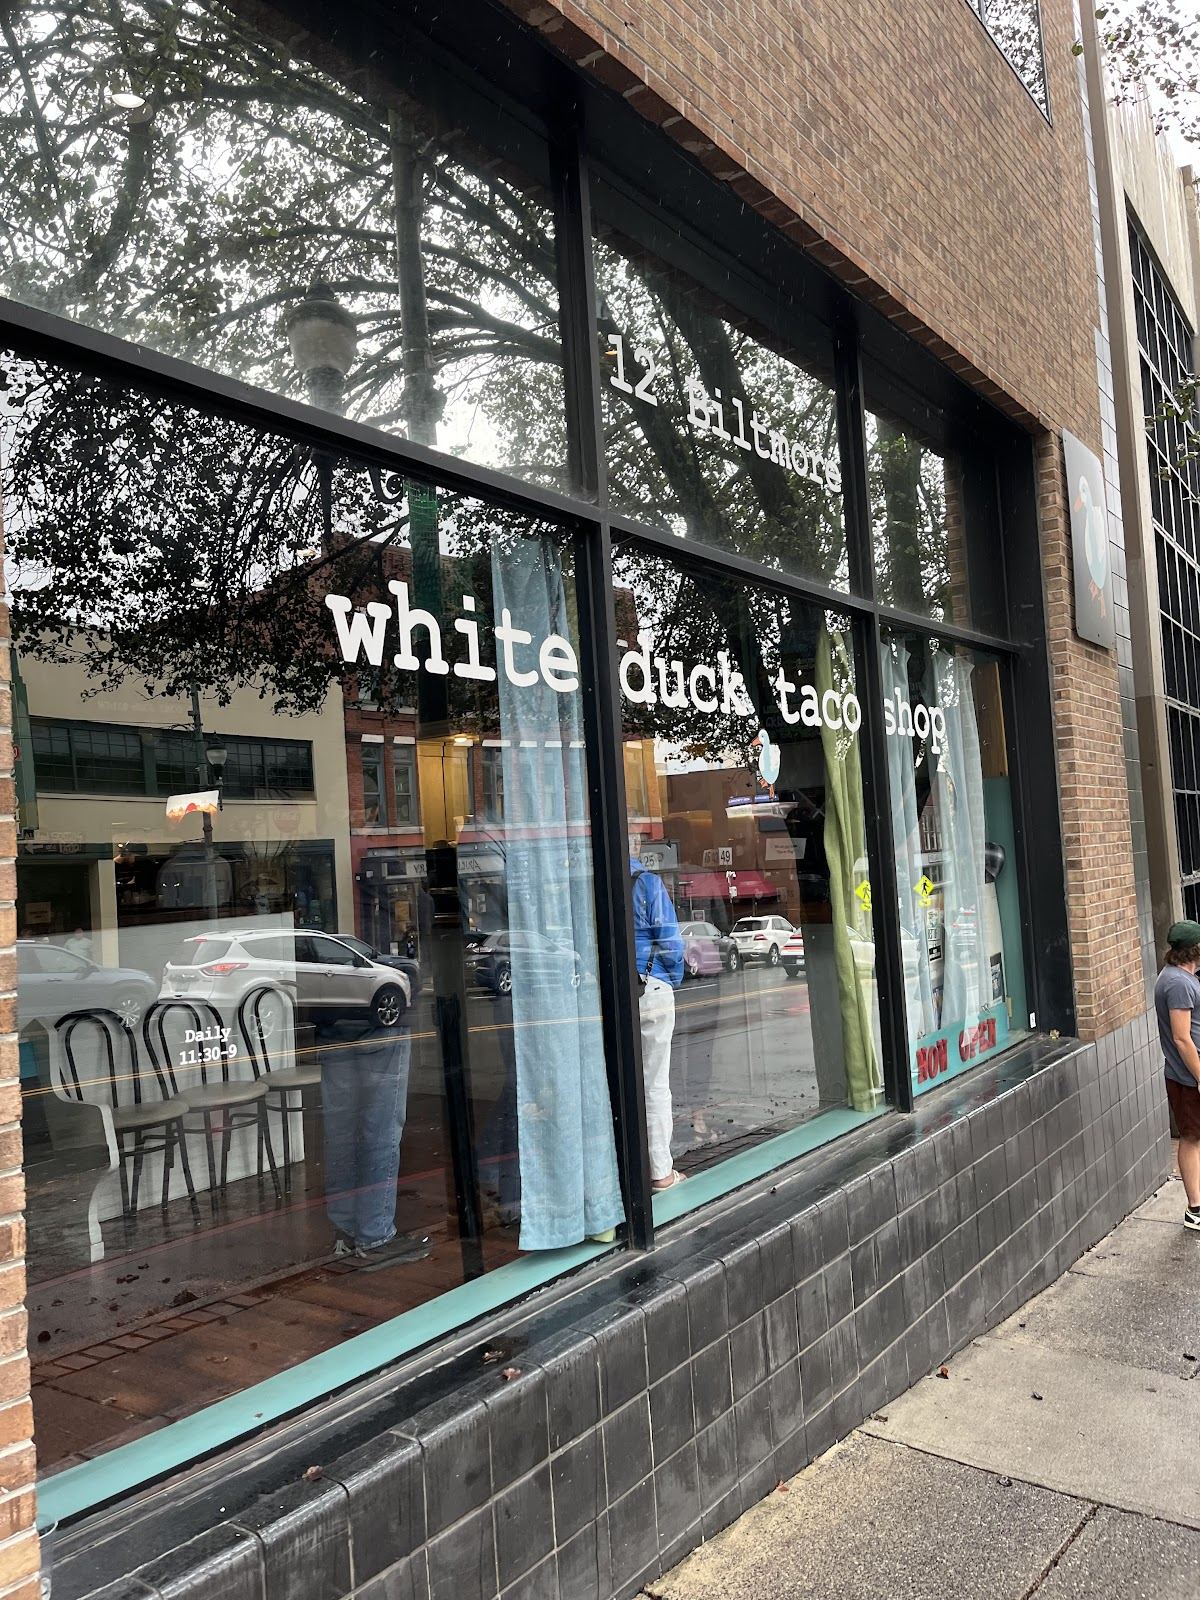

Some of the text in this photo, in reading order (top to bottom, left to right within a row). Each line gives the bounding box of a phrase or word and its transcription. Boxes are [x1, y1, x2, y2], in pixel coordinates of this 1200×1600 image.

[607, 333, 842, 493] 12 Biltmore
[324, 579, 946, 754] white duck taco shop
[179, 1043, 238, 1066] 11:30-9
[184, 1025, 232, 1043] Daily
[916, 1018, 997, 1085] NOW OPEN
